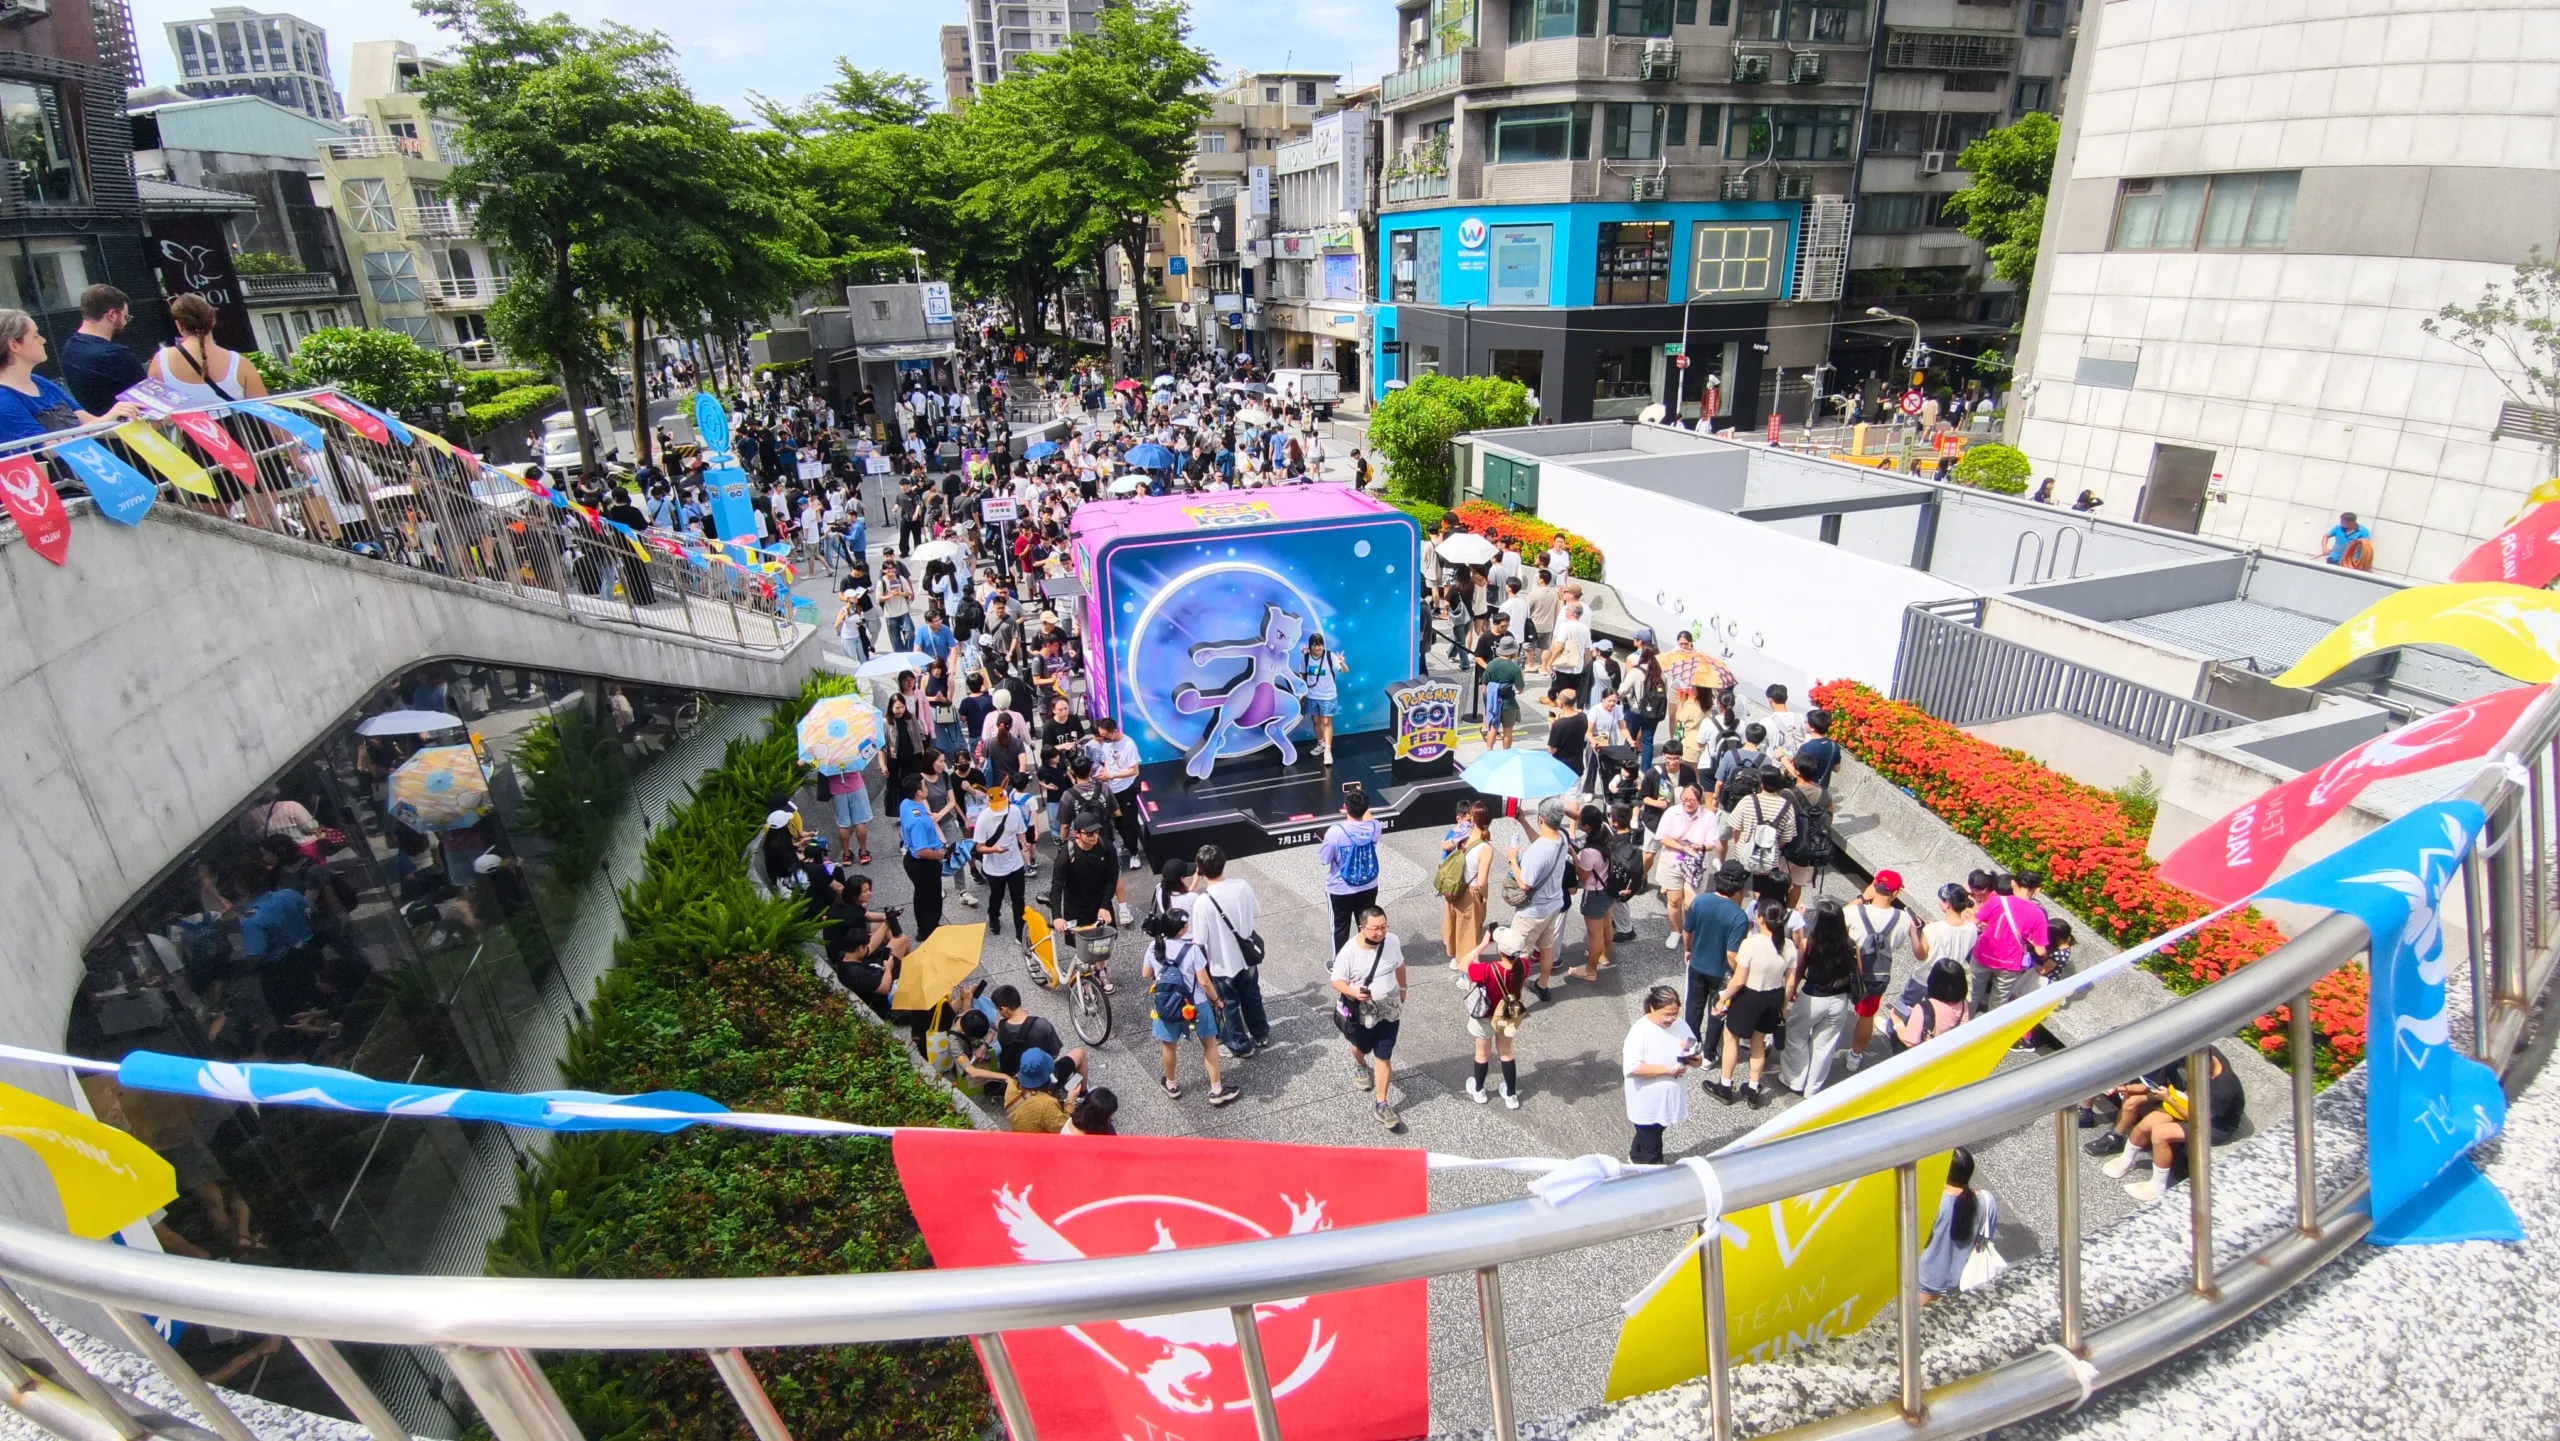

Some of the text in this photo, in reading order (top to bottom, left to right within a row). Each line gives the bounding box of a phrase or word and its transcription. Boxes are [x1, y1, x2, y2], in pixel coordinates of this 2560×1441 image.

[1410, 705, 1446, 726] GO
[1410, 731, 1447, 746] FEST
[1418, 746, 1437, 755] 2026
[1734, 1275, 1826, 1339] TEAM
